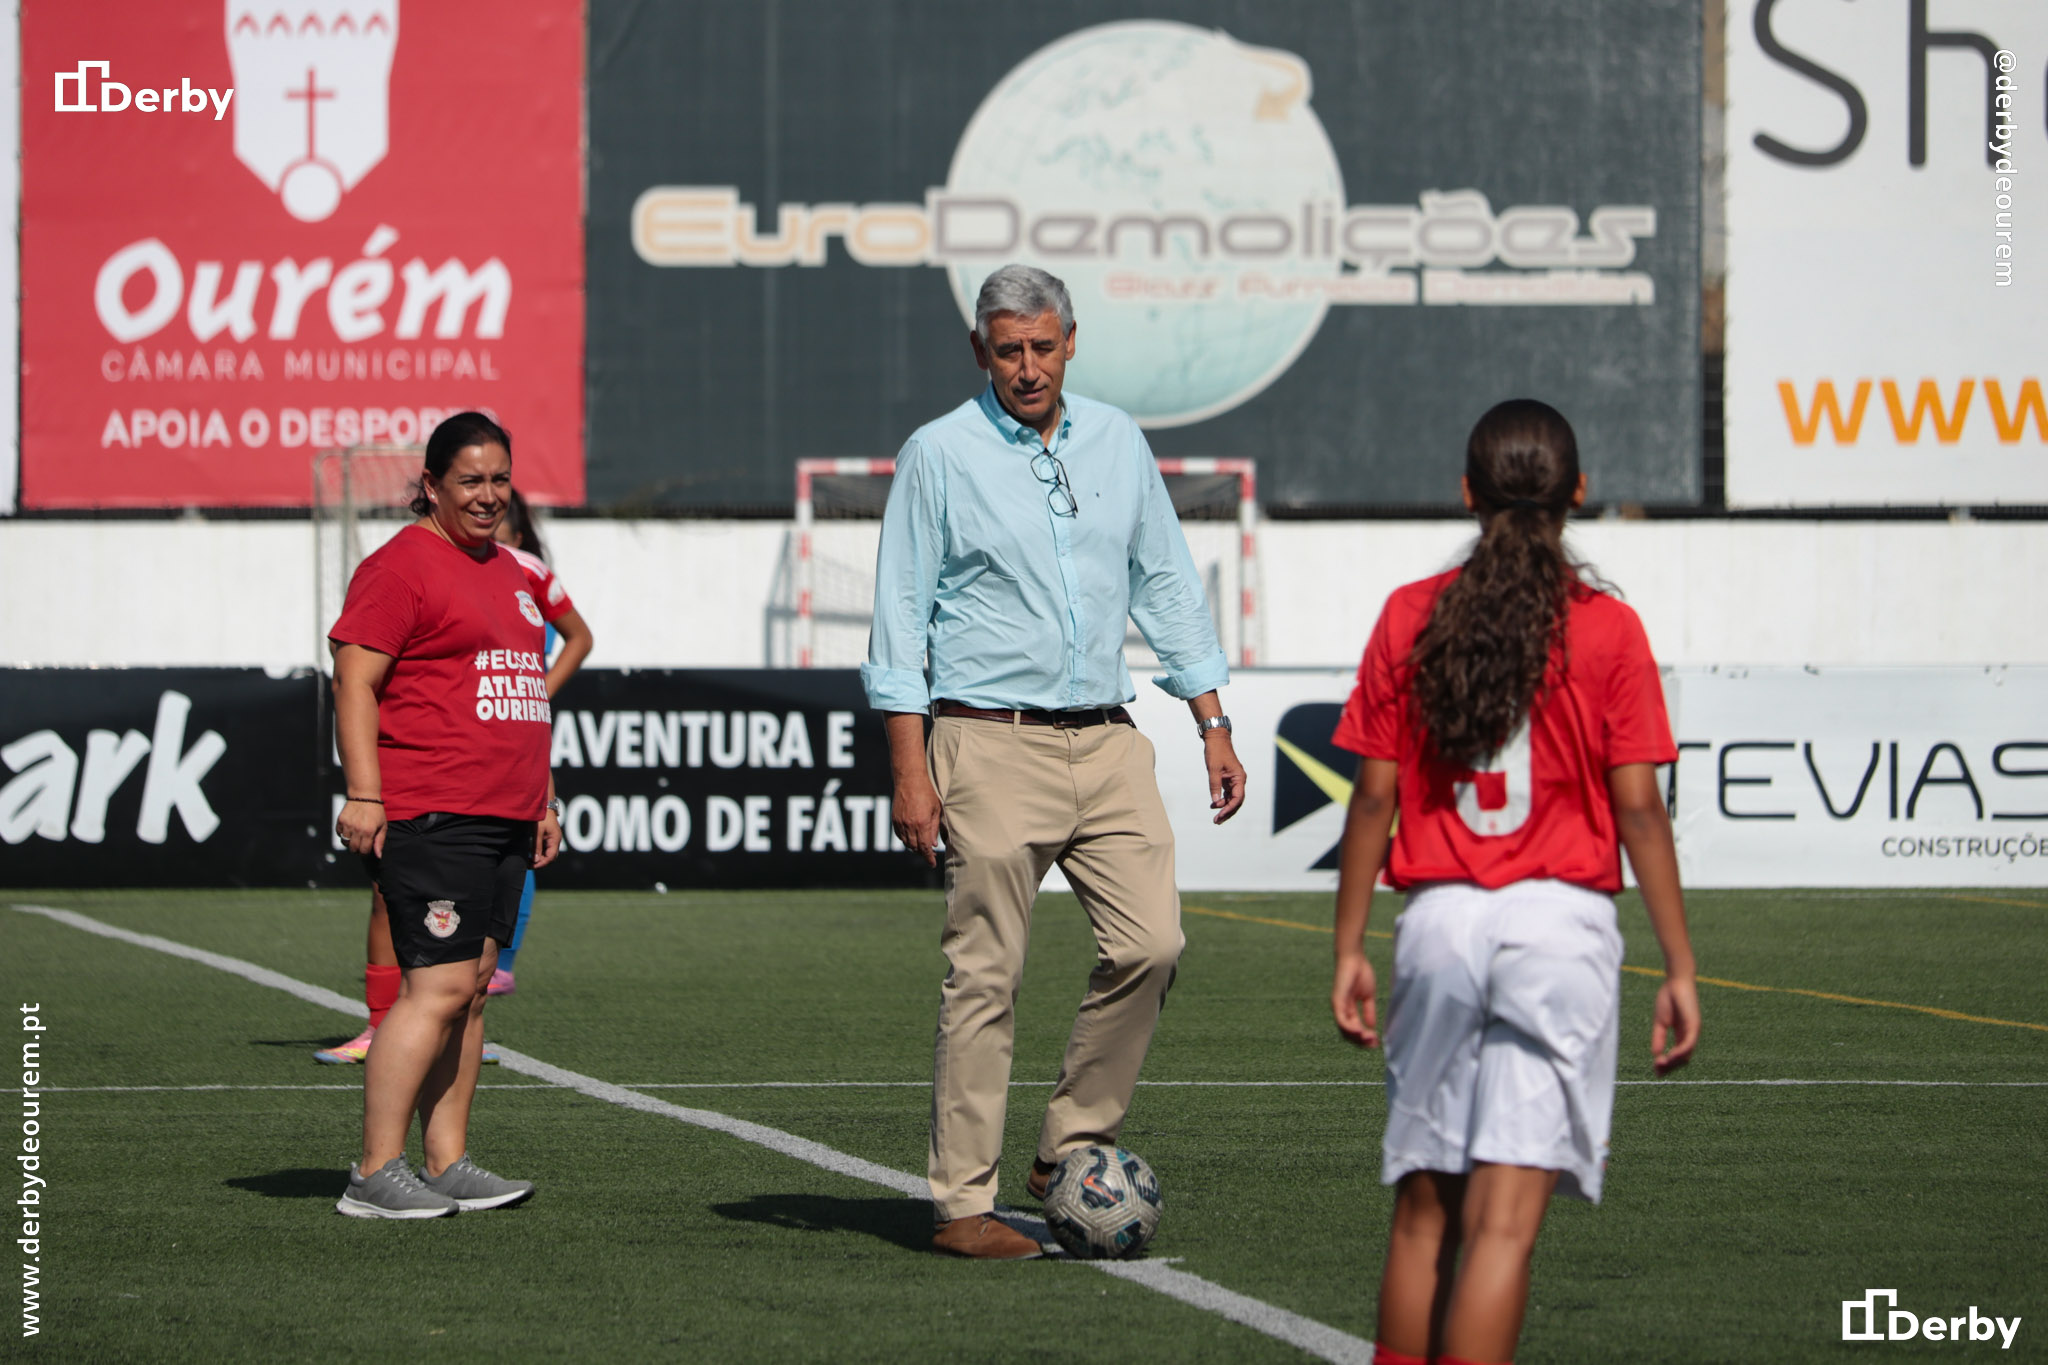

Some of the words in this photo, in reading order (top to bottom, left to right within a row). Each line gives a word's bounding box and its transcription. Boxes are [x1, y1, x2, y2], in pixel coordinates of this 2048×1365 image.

[94, 224, 511, 342] Ourém
[101, 348, 264, 382] CÂMARA
[284, 350, 500, 381] MUNICIPAL
[102, 410, 231, 448] APOIA
[240, 410, 270, 447] O
[281, 408, 500, 448] DESPOR
[551, 711, 814, 768] AVENTURA
[827, 712, 854, 767] E
[706, 797, 771, 852] DE
